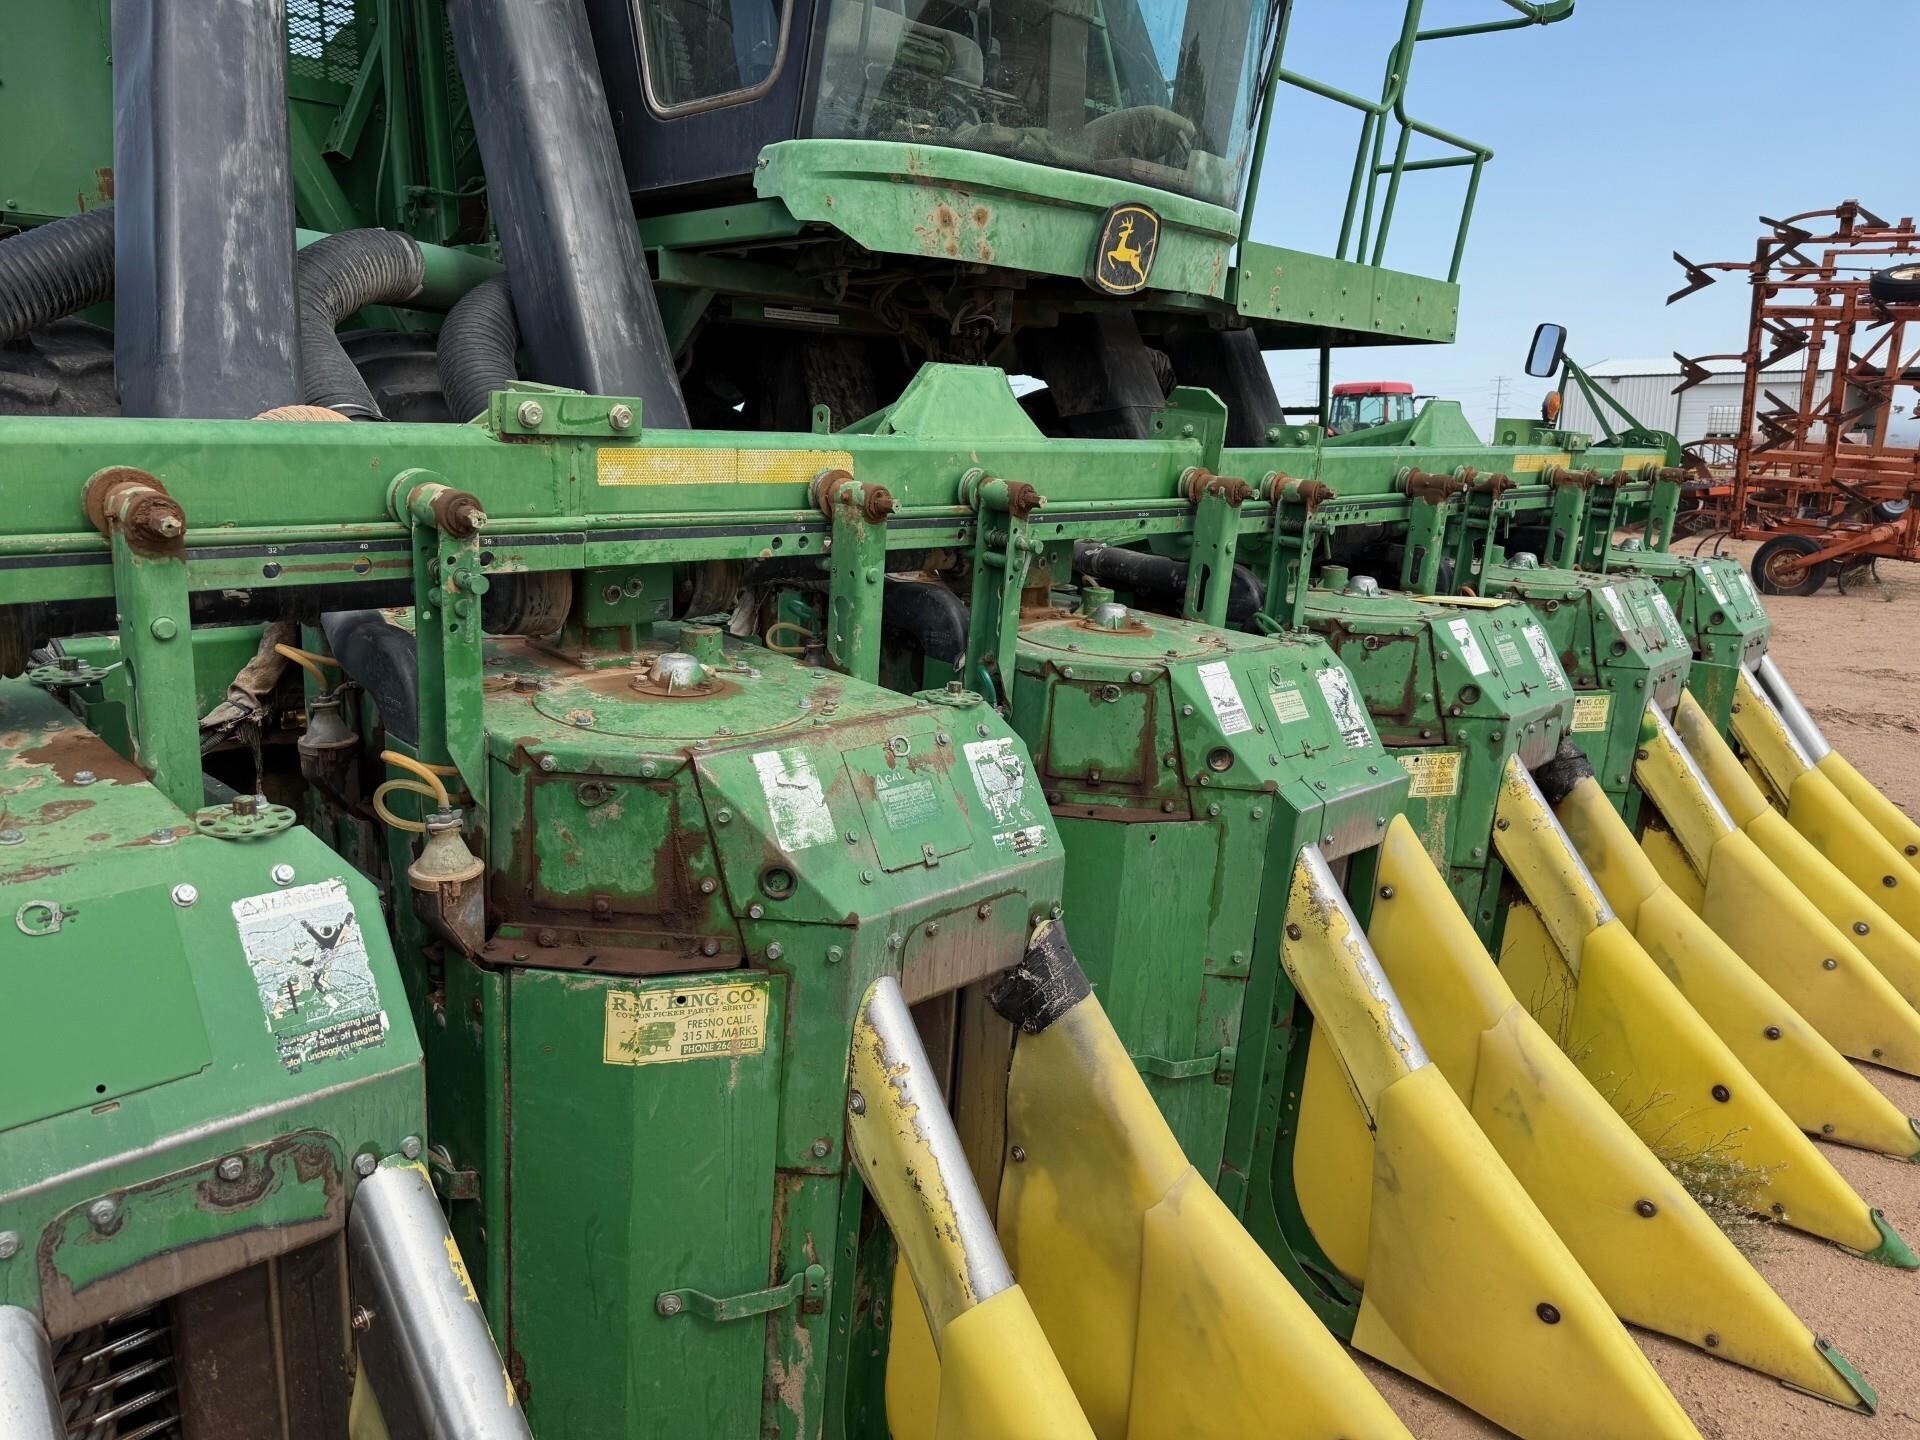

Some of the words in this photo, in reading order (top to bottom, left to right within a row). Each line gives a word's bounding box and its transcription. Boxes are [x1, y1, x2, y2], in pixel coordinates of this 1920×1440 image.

[667, 992, 720, 1010] KING
[726, 989, 761, 1005] CO.
[361, 1013, 377, 1023] unit
[653, 1010, 685, 1018] PICKER
[687, 1007, 715, 1016] PARTS
[722, 1003, 758, 1012] SERVICE
[687, 1017, 724, 1029] FRESNO
[726, 1015, 755, 1026] CALIF.
[340, 1031, 352, 1042] off
[352, 1023, 380, 1038] engine
[682, 1031, 702, 1042] 315
[706, 1029, 718, 1040] N.
[721, 1025, 758, 1039] MARKS
[350, 1034, 384, 1050] machine.
[683, 1043, 714, 1054] PHONE
